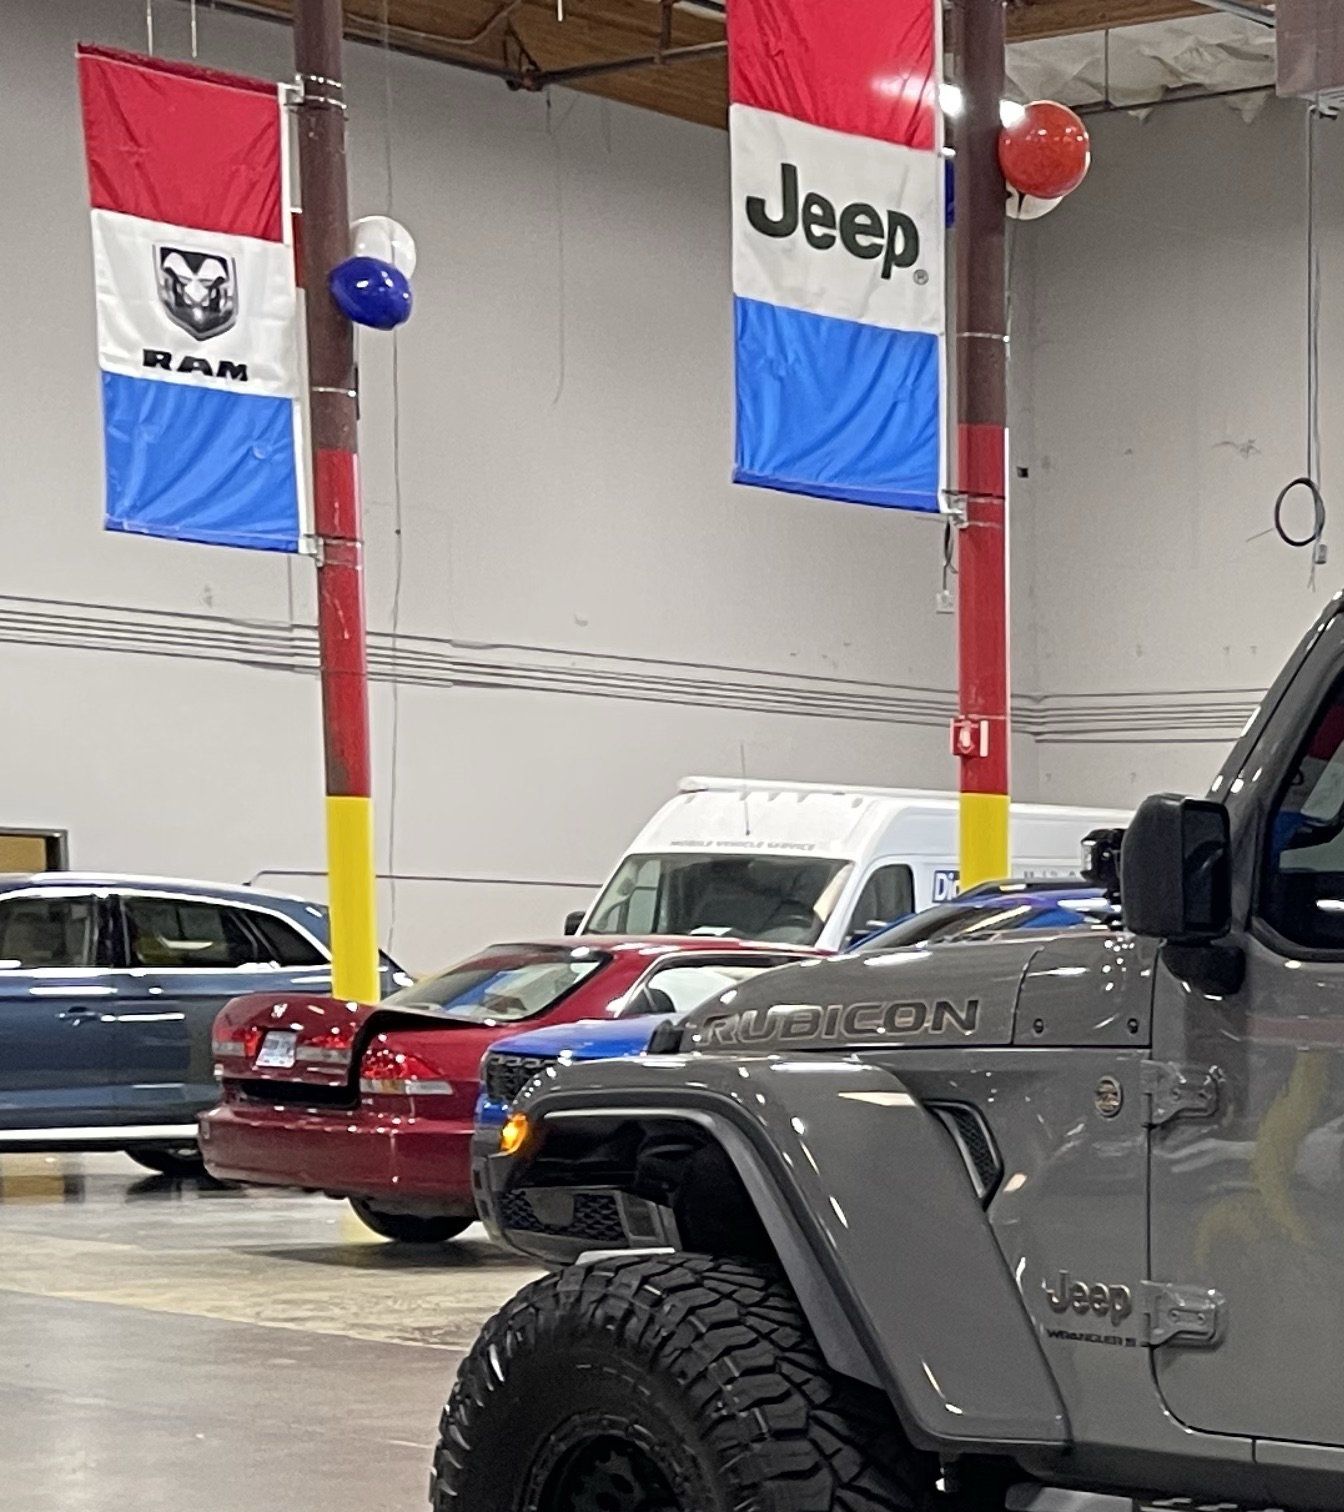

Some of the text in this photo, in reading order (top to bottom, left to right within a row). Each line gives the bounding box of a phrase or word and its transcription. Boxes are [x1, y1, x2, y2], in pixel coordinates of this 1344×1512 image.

[746, 163, 919, 280] Jeep
[142, 348, 248, 381] RAM
[935, 871, 960, 901] Di
[701, 999, 979, 1046] RUBICON
[1041, 1269, 1132, 1327] Jeep
